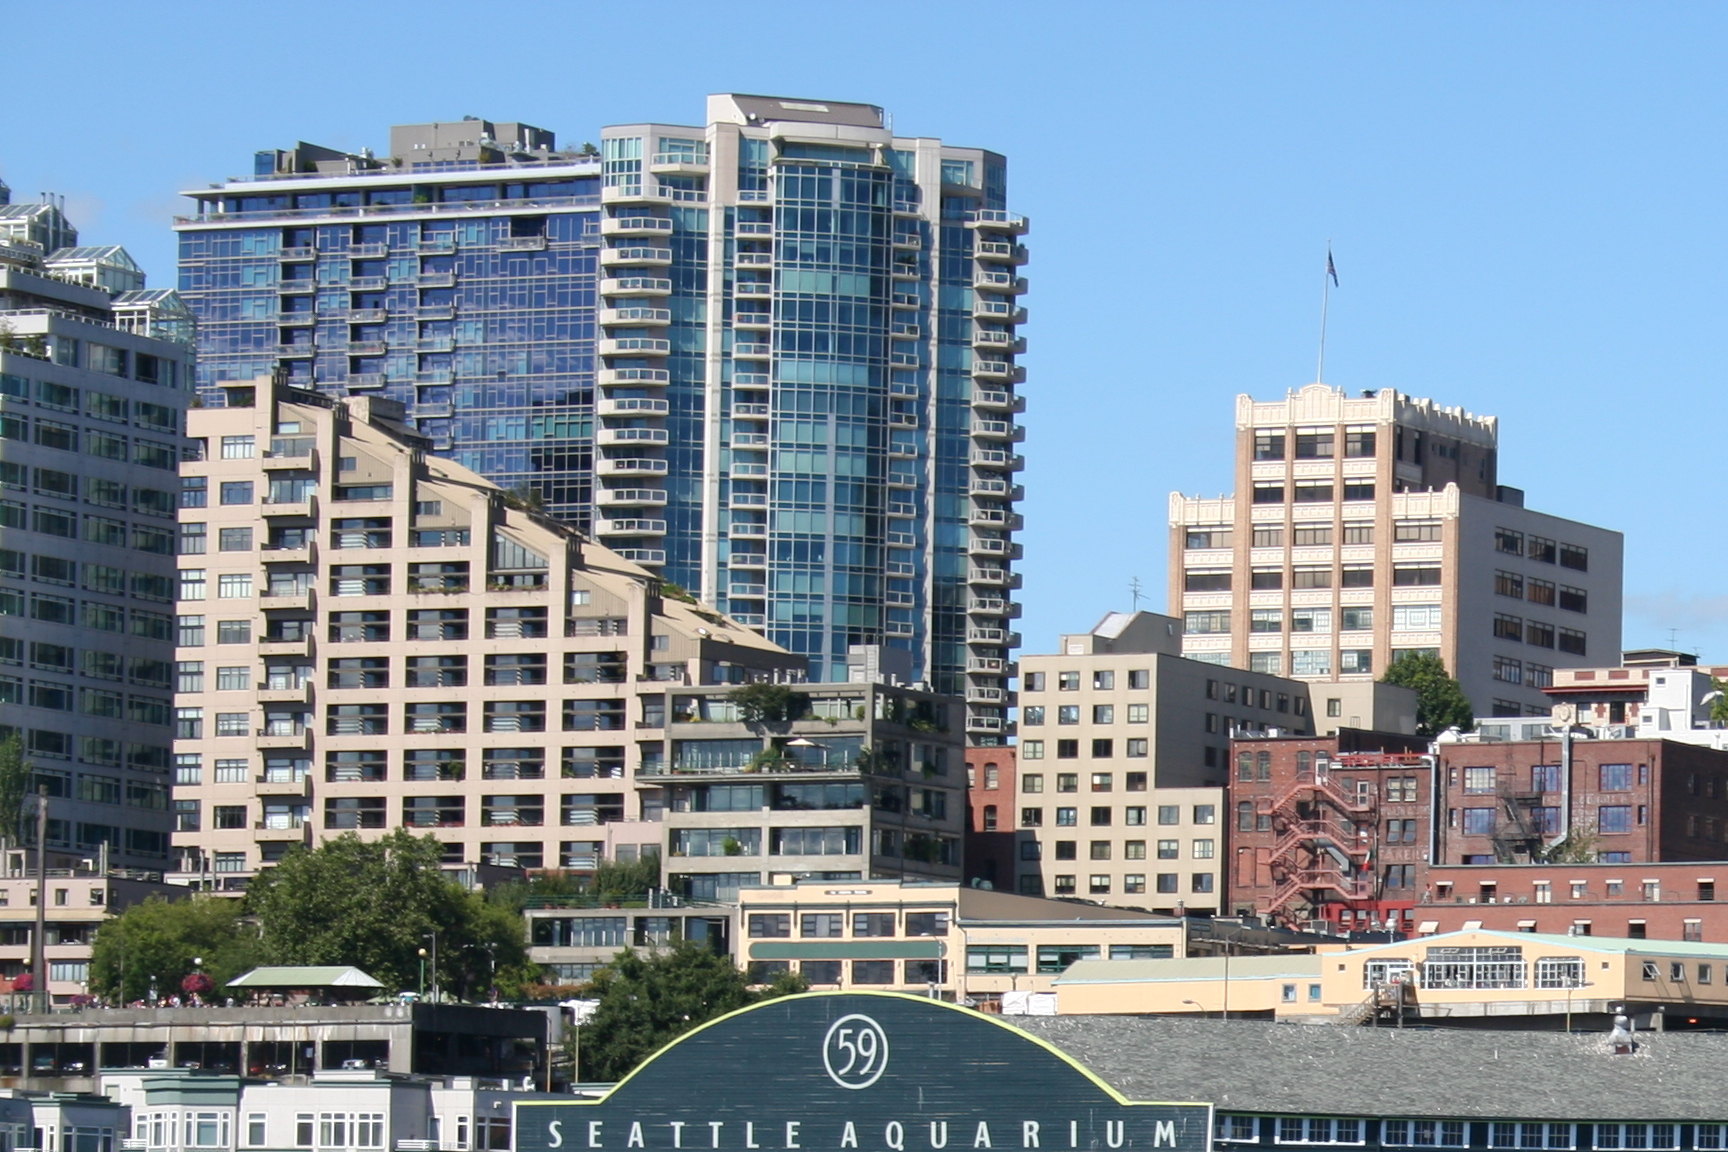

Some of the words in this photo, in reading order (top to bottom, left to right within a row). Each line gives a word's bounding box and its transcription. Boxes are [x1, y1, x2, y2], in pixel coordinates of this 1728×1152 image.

[838, 1028, 877, 1075] 59
[549, 1121, 800, 1149] SEATTLE
[840, 1120, 1176, 1151] AQUARIUM
